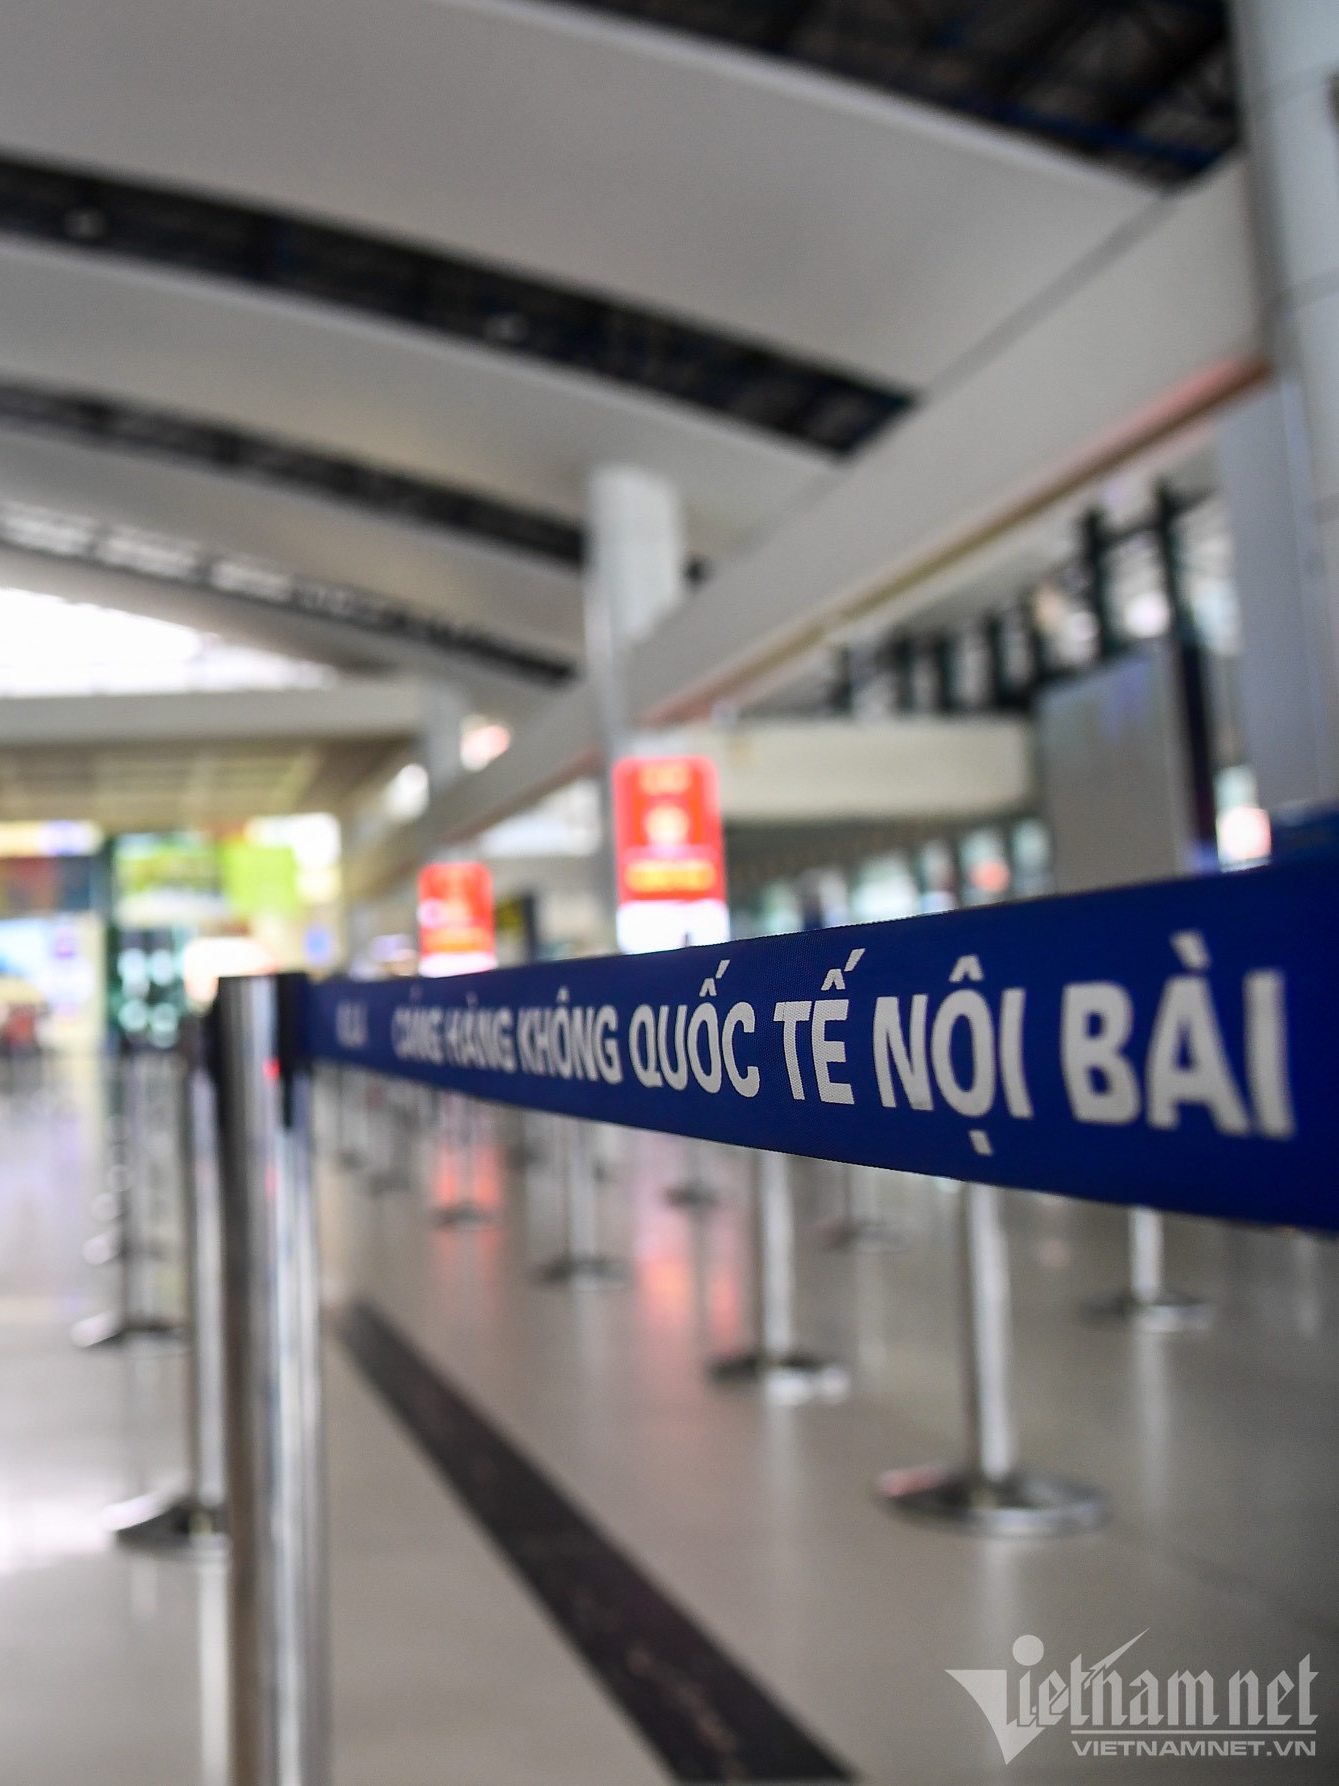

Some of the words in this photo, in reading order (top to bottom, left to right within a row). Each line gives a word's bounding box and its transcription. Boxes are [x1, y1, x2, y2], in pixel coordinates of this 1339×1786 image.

[517, 985, 623, 1085] KHÔNG
[628, 958, 761, 1099] QUỐC
[773, 948, 866, 1105] TẾ
[872, 954, 1035, 1157] NỘI
[1060, 929, 1298, 1142] BÀI
